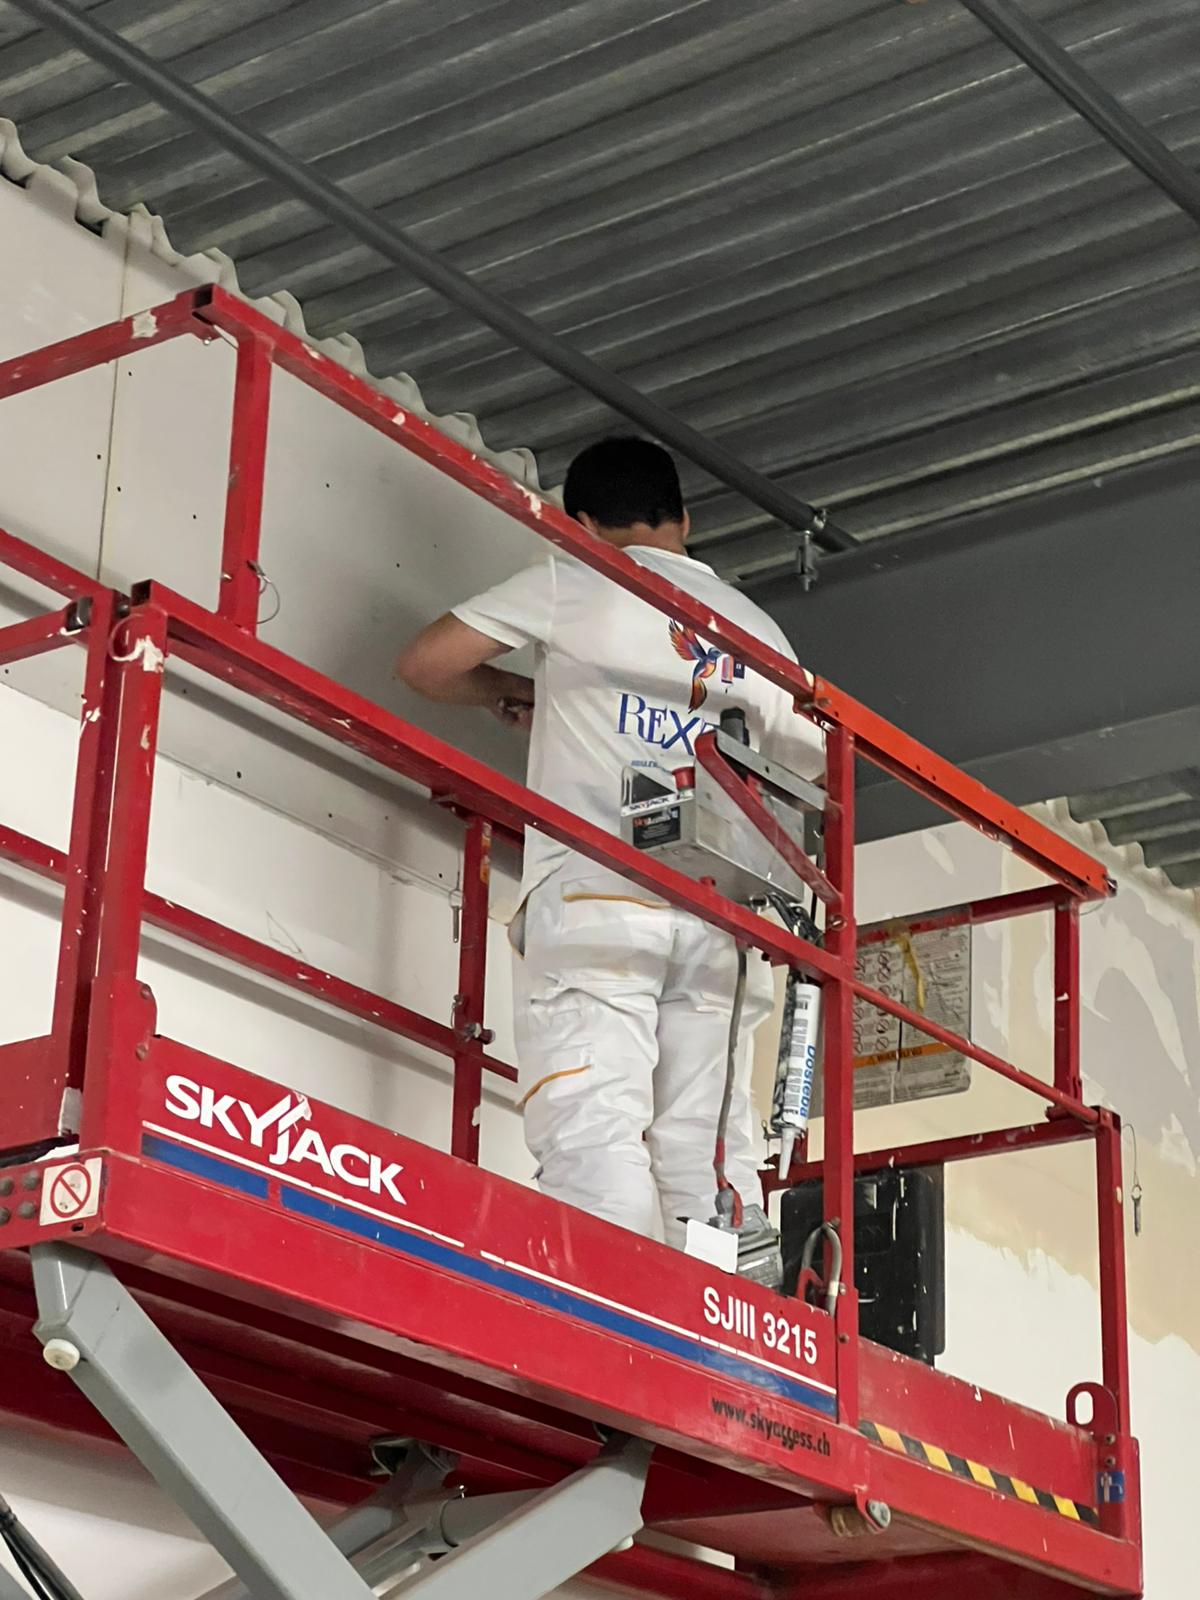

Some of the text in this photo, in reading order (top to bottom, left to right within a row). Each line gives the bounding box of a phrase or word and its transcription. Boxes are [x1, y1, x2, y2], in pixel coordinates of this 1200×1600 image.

[165, 1074, 407, 1205] SKYJACK
[703, 1287, 817, 1365] SJIII 3215
